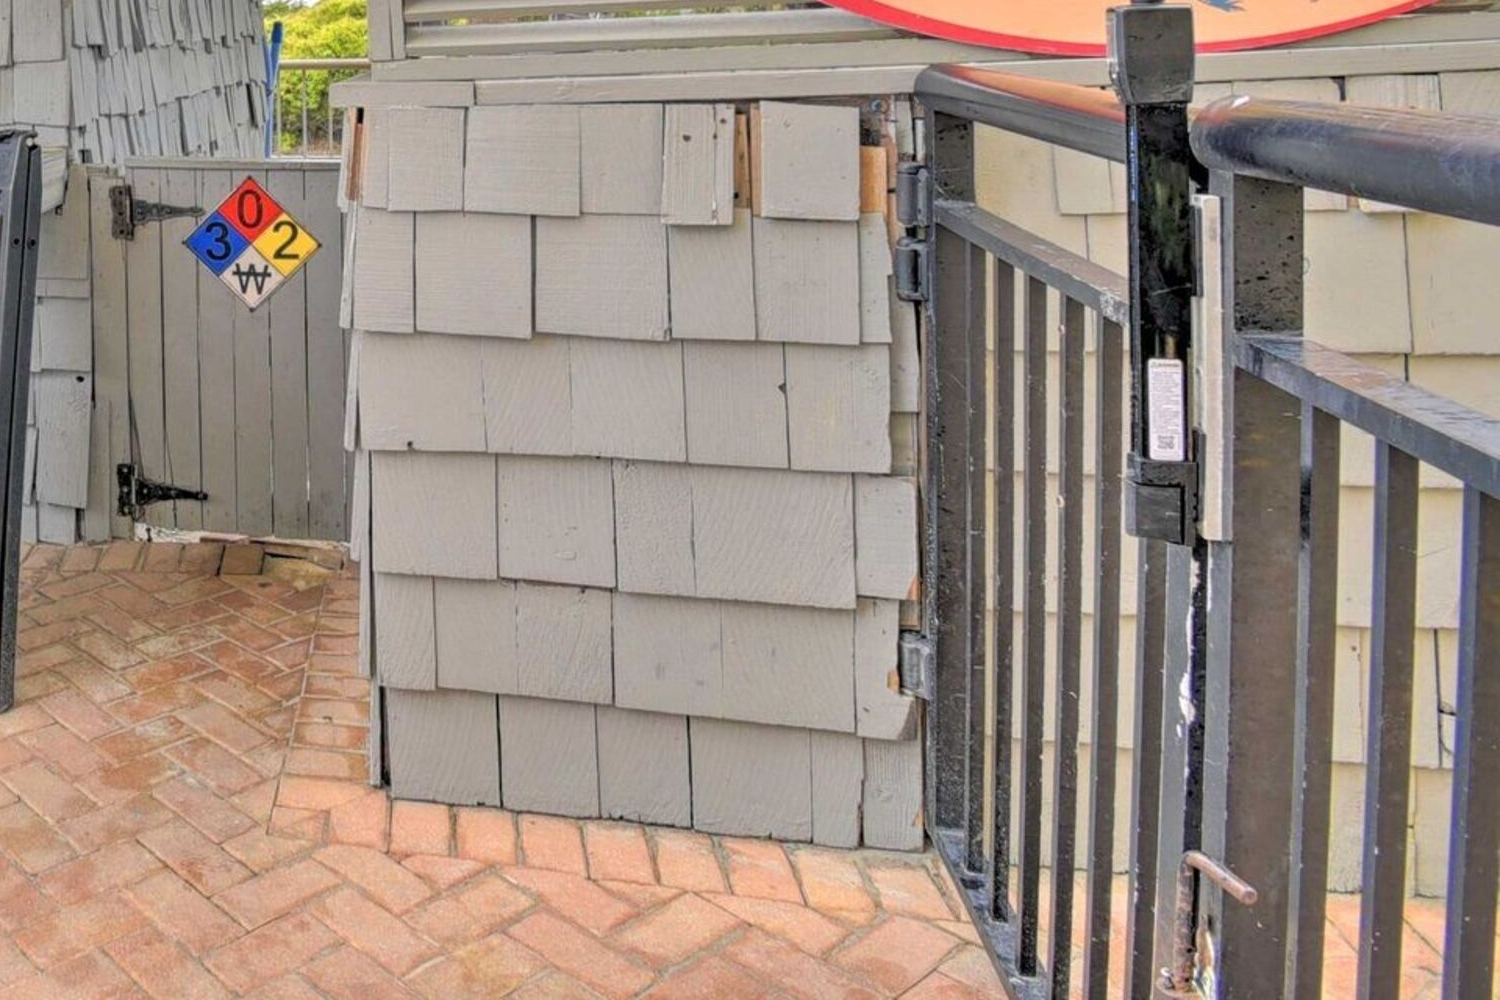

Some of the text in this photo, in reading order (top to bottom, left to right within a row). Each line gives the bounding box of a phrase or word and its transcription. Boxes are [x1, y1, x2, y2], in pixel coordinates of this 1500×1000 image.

[237, 189, 263, 228] 0
[205, 220, 299, 261] 3 2
